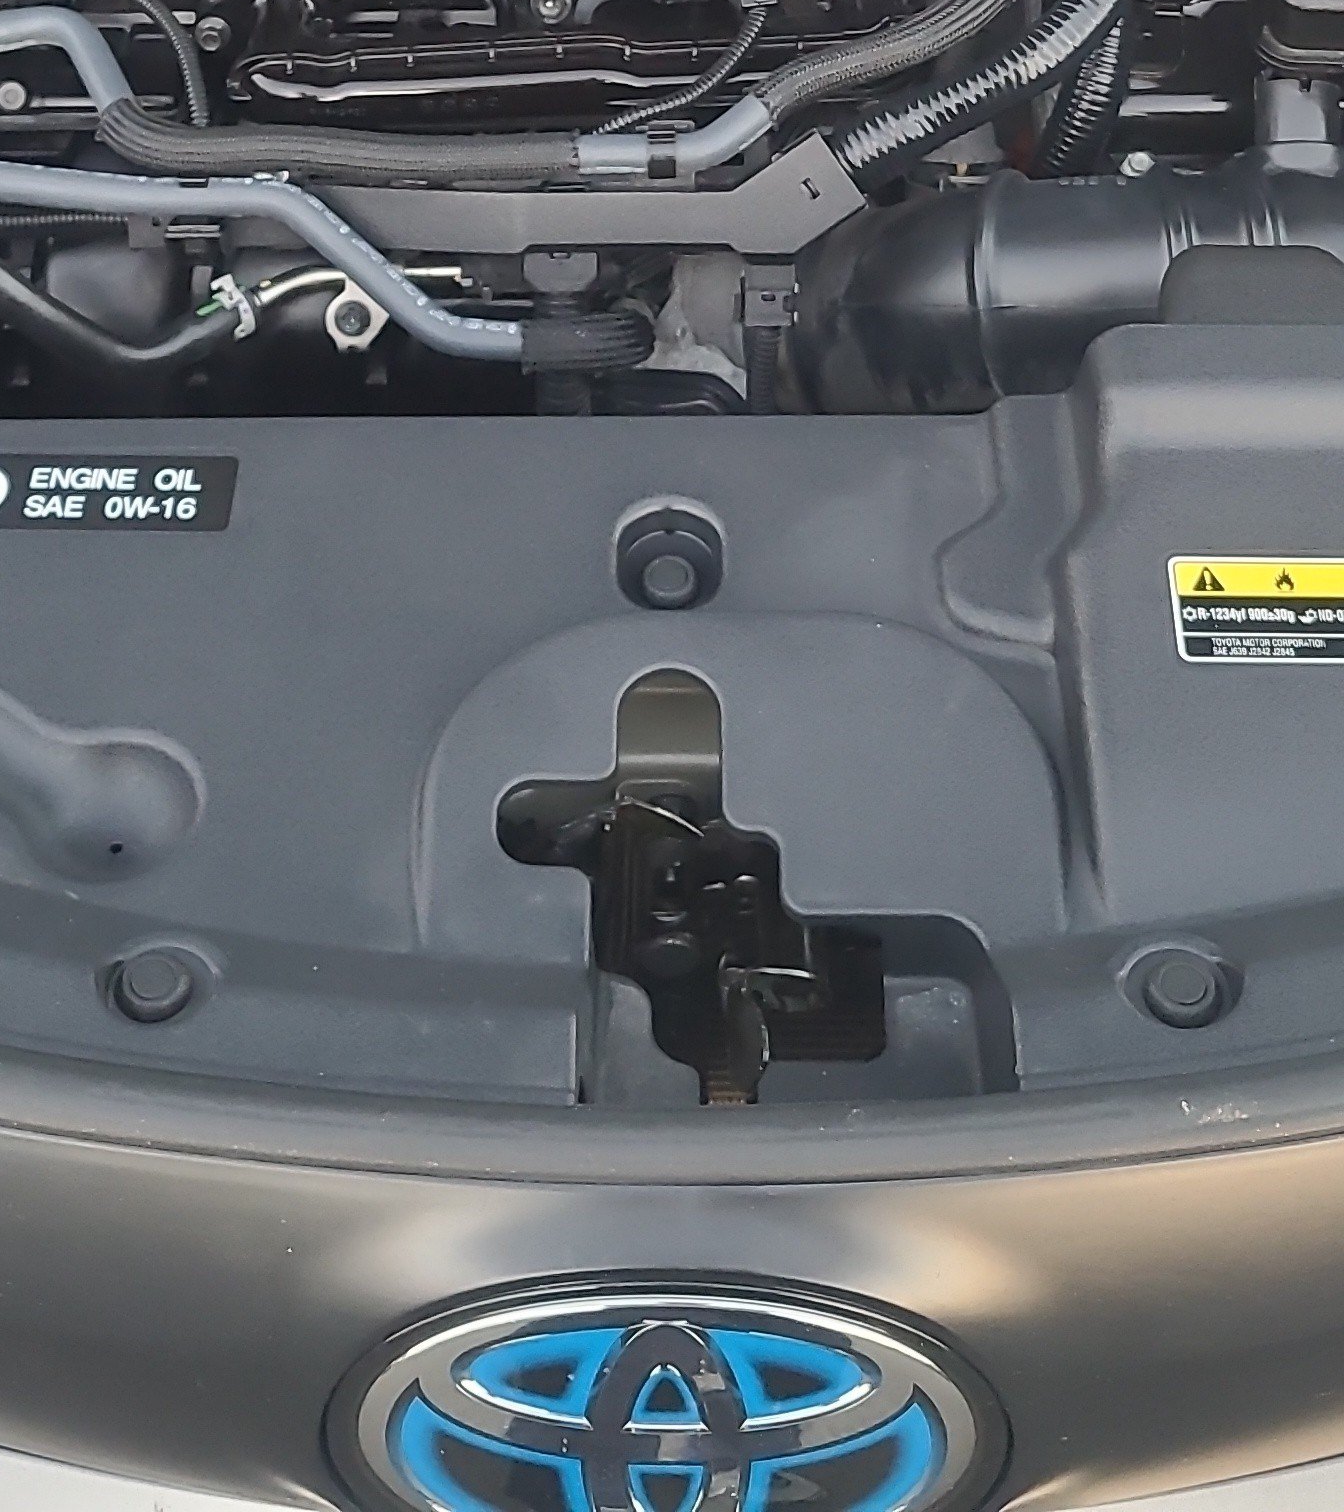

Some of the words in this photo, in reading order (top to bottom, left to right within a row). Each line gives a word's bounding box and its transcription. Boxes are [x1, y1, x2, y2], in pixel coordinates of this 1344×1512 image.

[29, 467, 140, 492] ENGINE
[153, 468, 203, 492] OIL
[23, 495, 87, 519] SAE
[103, 496, 198, 520] 0W-16
[1211, 637, 1242, 647] TOYOTA
[1242, 638, 1271, 647] MOTOR
[1271, 638, 1327, 649] CORPORATION
[1212, 647, 1229, 655] SAE
